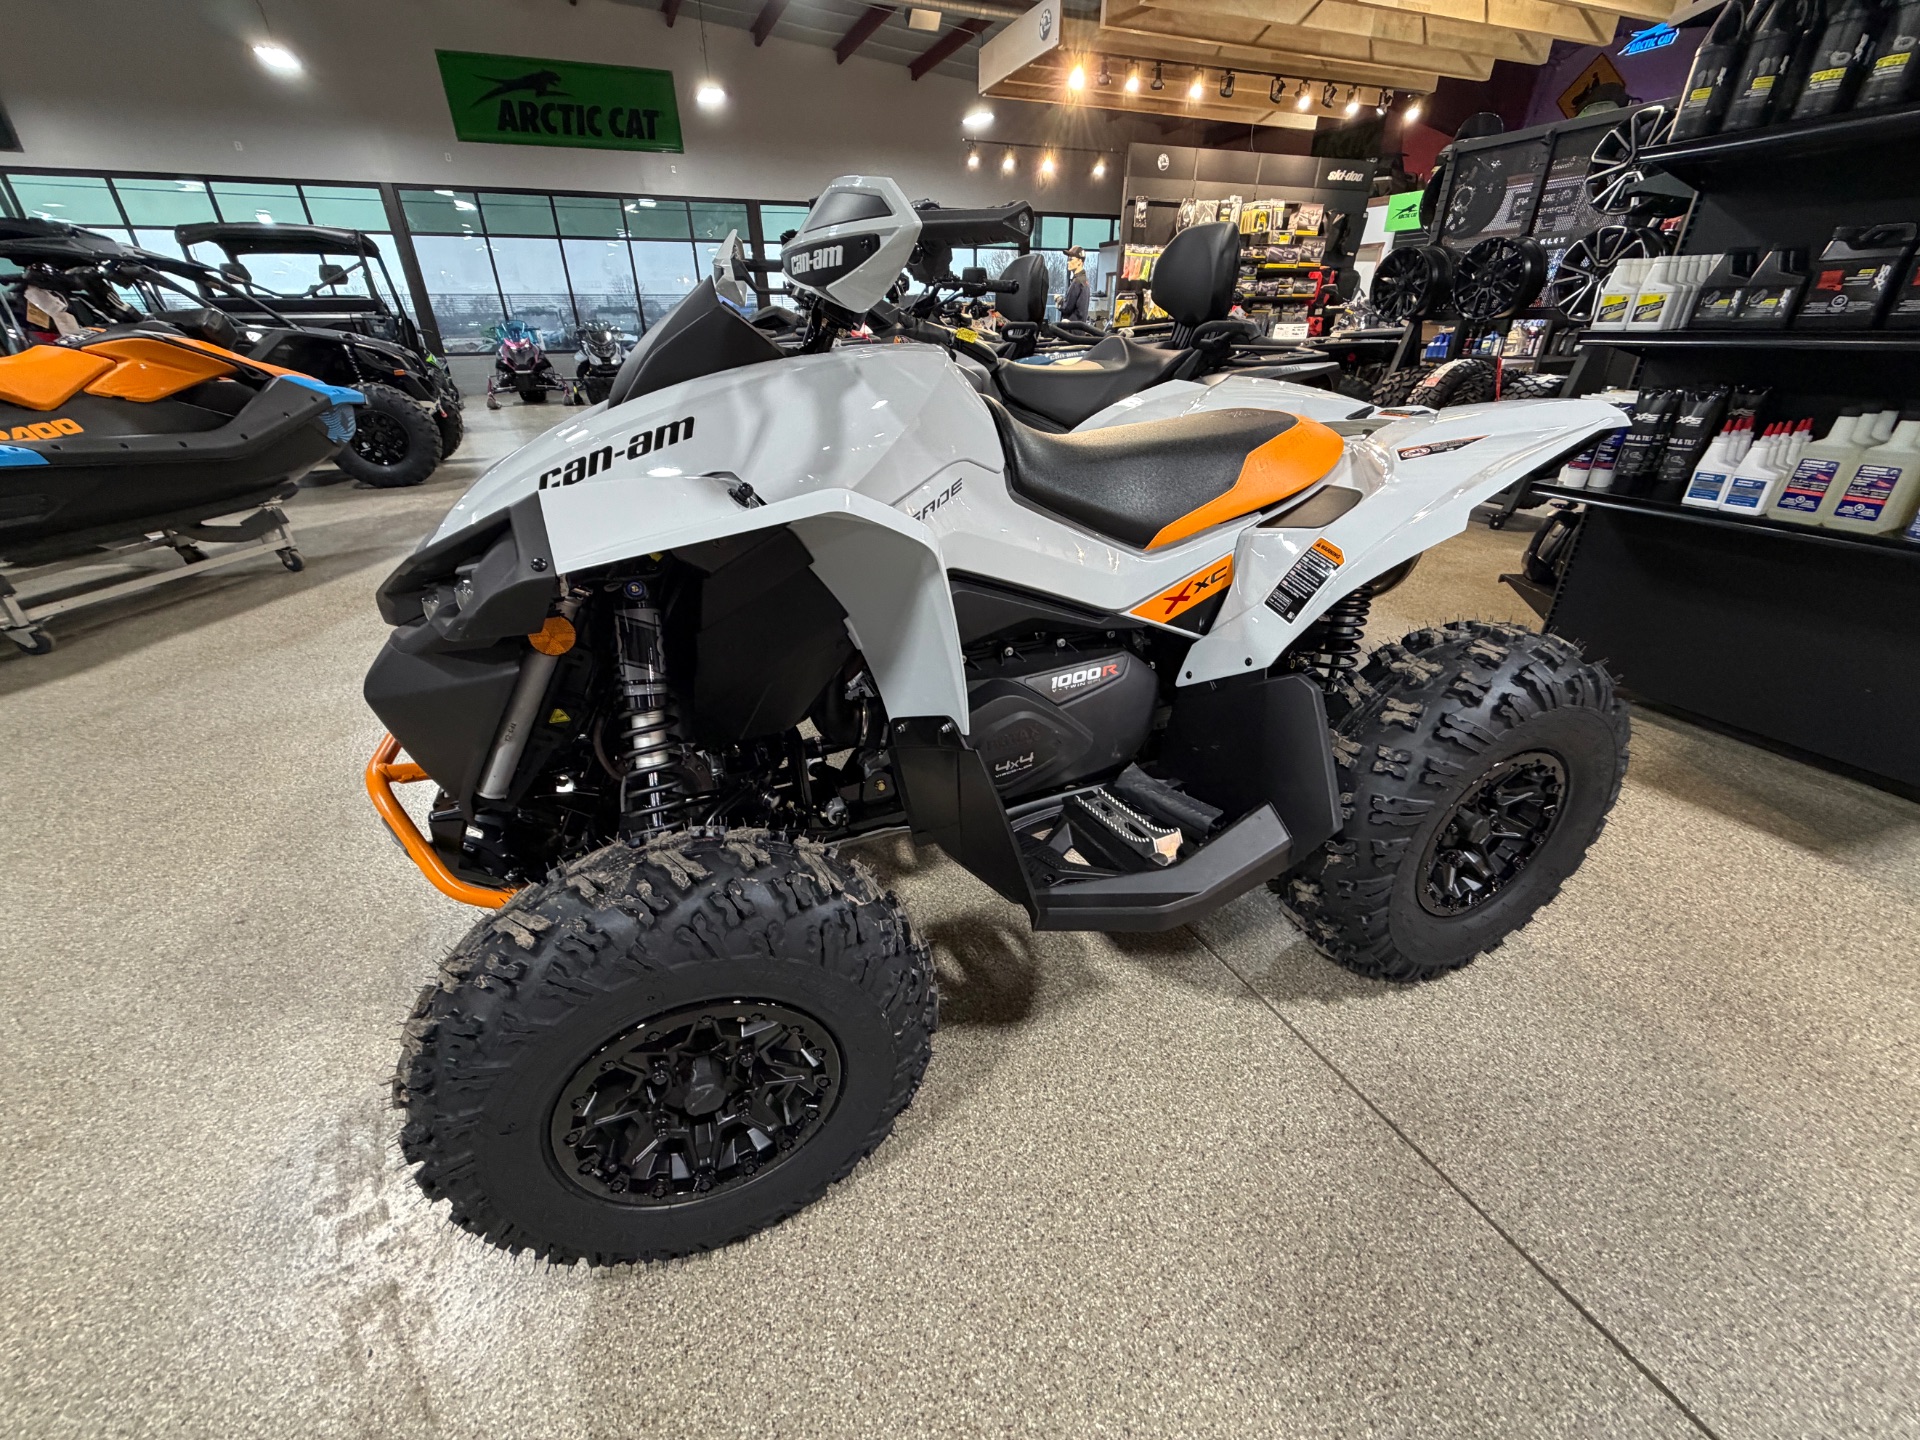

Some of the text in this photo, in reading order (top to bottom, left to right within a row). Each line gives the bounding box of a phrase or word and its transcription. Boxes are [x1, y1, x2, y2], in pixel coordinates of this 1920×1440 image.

[1628, 31, 1676, 54] ARCTIC CAT
[498, 100, 660, 140] ARCTIC CAT
[1327, 169, 1364, 182] ski-doo
[790, 244, 844, 276] can-am
[1872, 263, 1892, 292] XPS
[1633, 411, 1661, 422] XPS
[1676, 415, 1705, 426] XPS
[538, 416, 696, 491] can-am
[1051, 663, 1119, 690] 1000R
